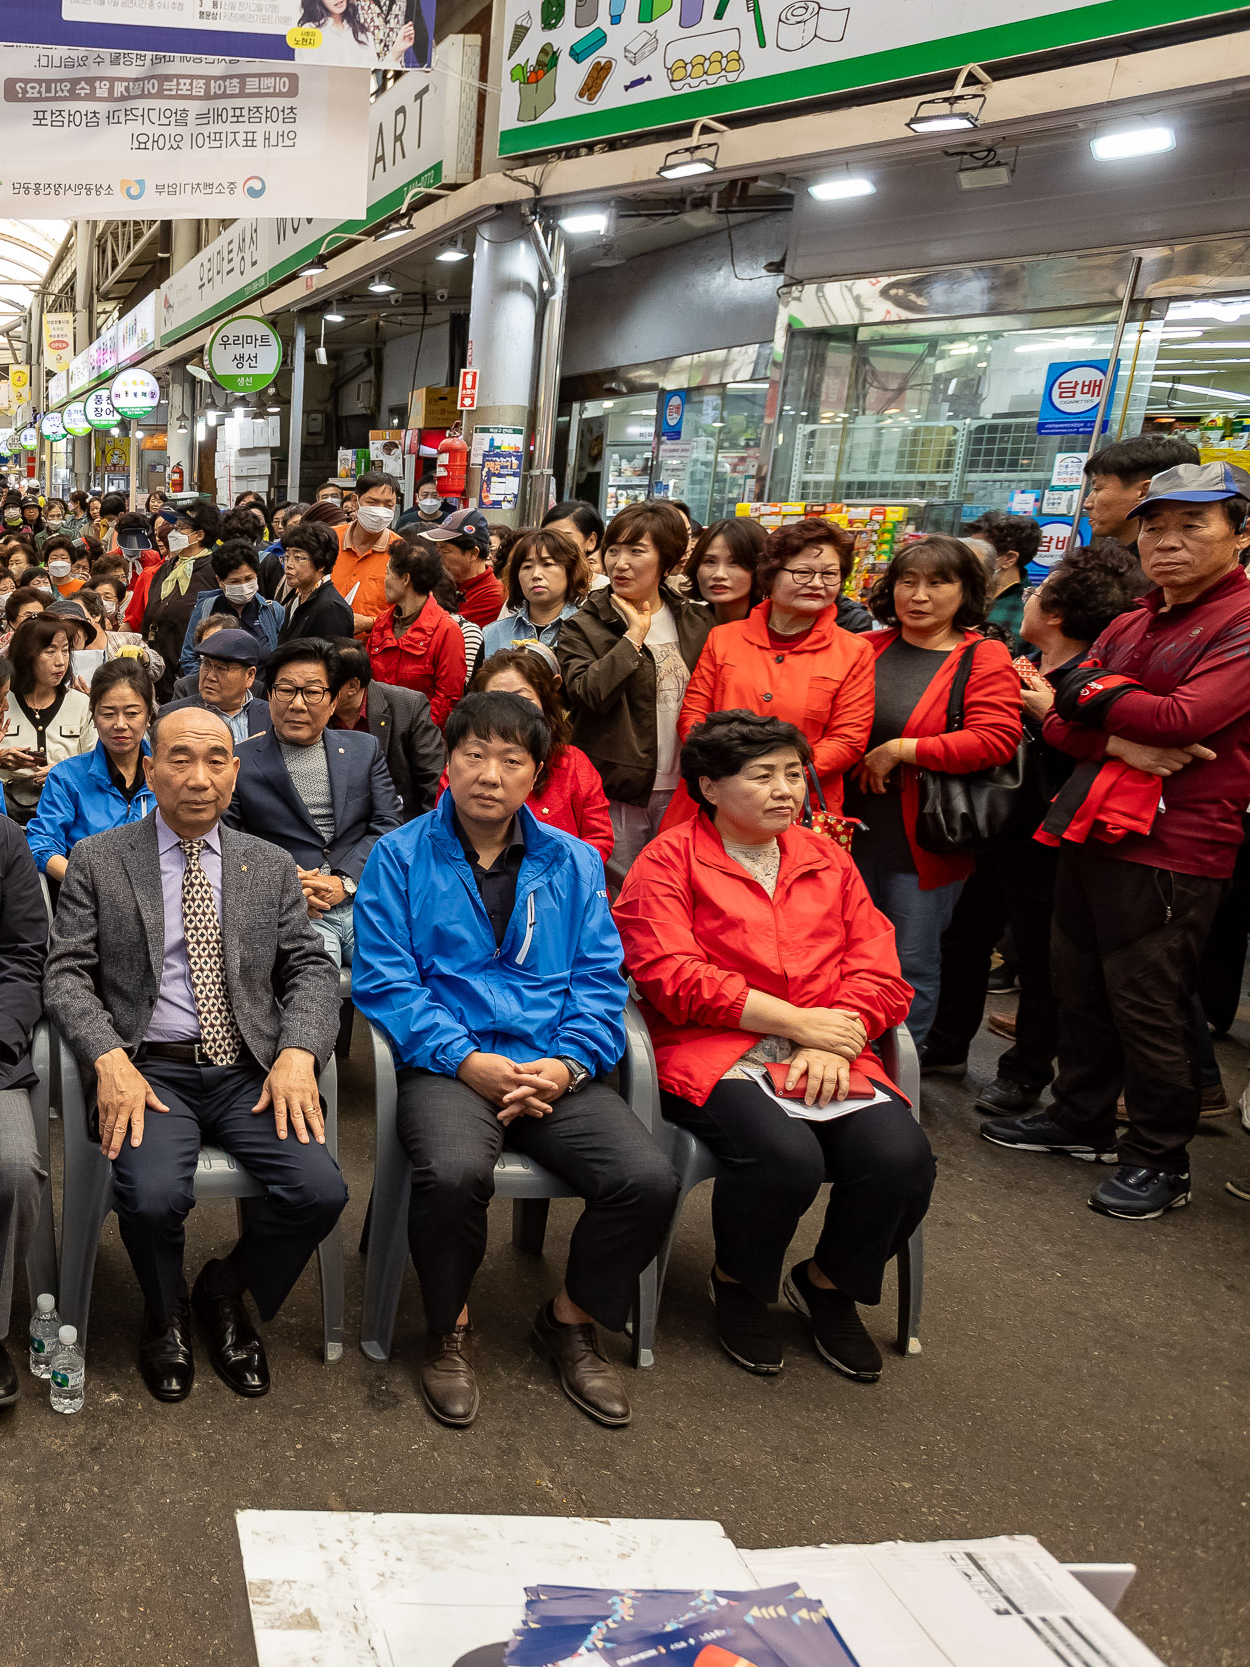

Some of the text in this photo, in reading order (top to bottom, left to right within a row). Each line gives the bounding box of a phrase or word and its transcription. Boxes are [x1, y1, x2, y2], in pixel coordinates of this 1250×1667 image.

[293, 37, 315, 47] 노현지
[218, 333, 272, 350] 우리마트
[231, 352, 259, 370] 생선
[16, 374, 21, 383] 4
[236, 376, 253, 387] 생선
[1057, 378, 1103, 400] 담배
[93, 407, 115, 418] 장어
